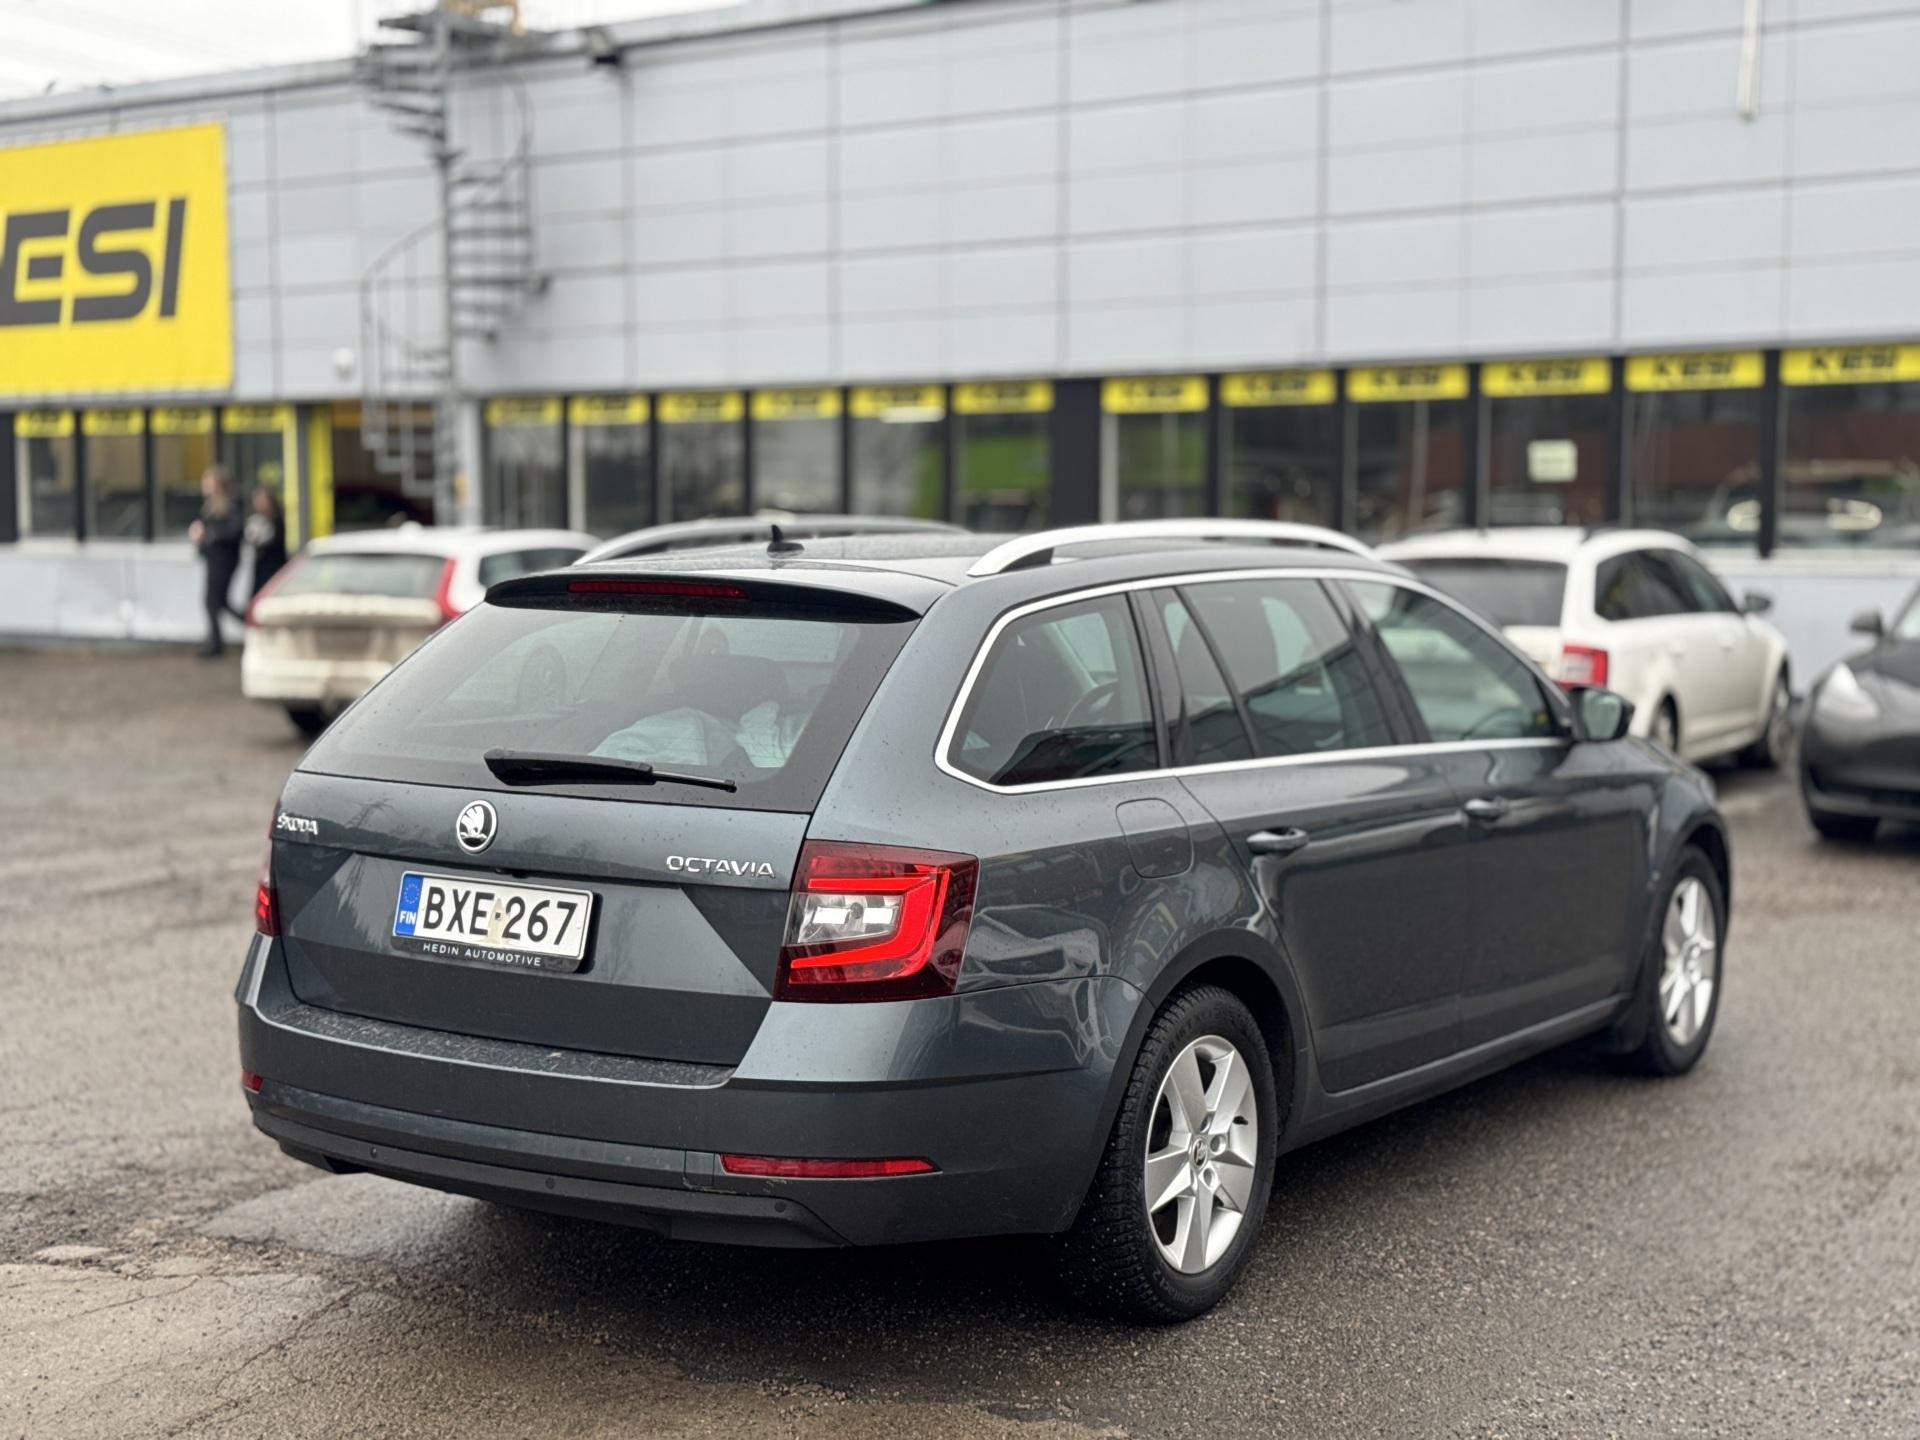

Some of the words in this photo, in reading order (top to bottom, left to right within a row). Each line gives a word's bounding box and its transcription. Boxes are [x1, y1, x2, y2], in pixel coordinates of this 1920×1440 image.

[0, 198, 186, 326] ESI
[666, 856, 776, 879] OCTAVIA
[399, 910, 417, 925] FIN
[423, 942, 459, 957] HEDIN
[464, 948, 541, 967] AUTOMOTIVE
